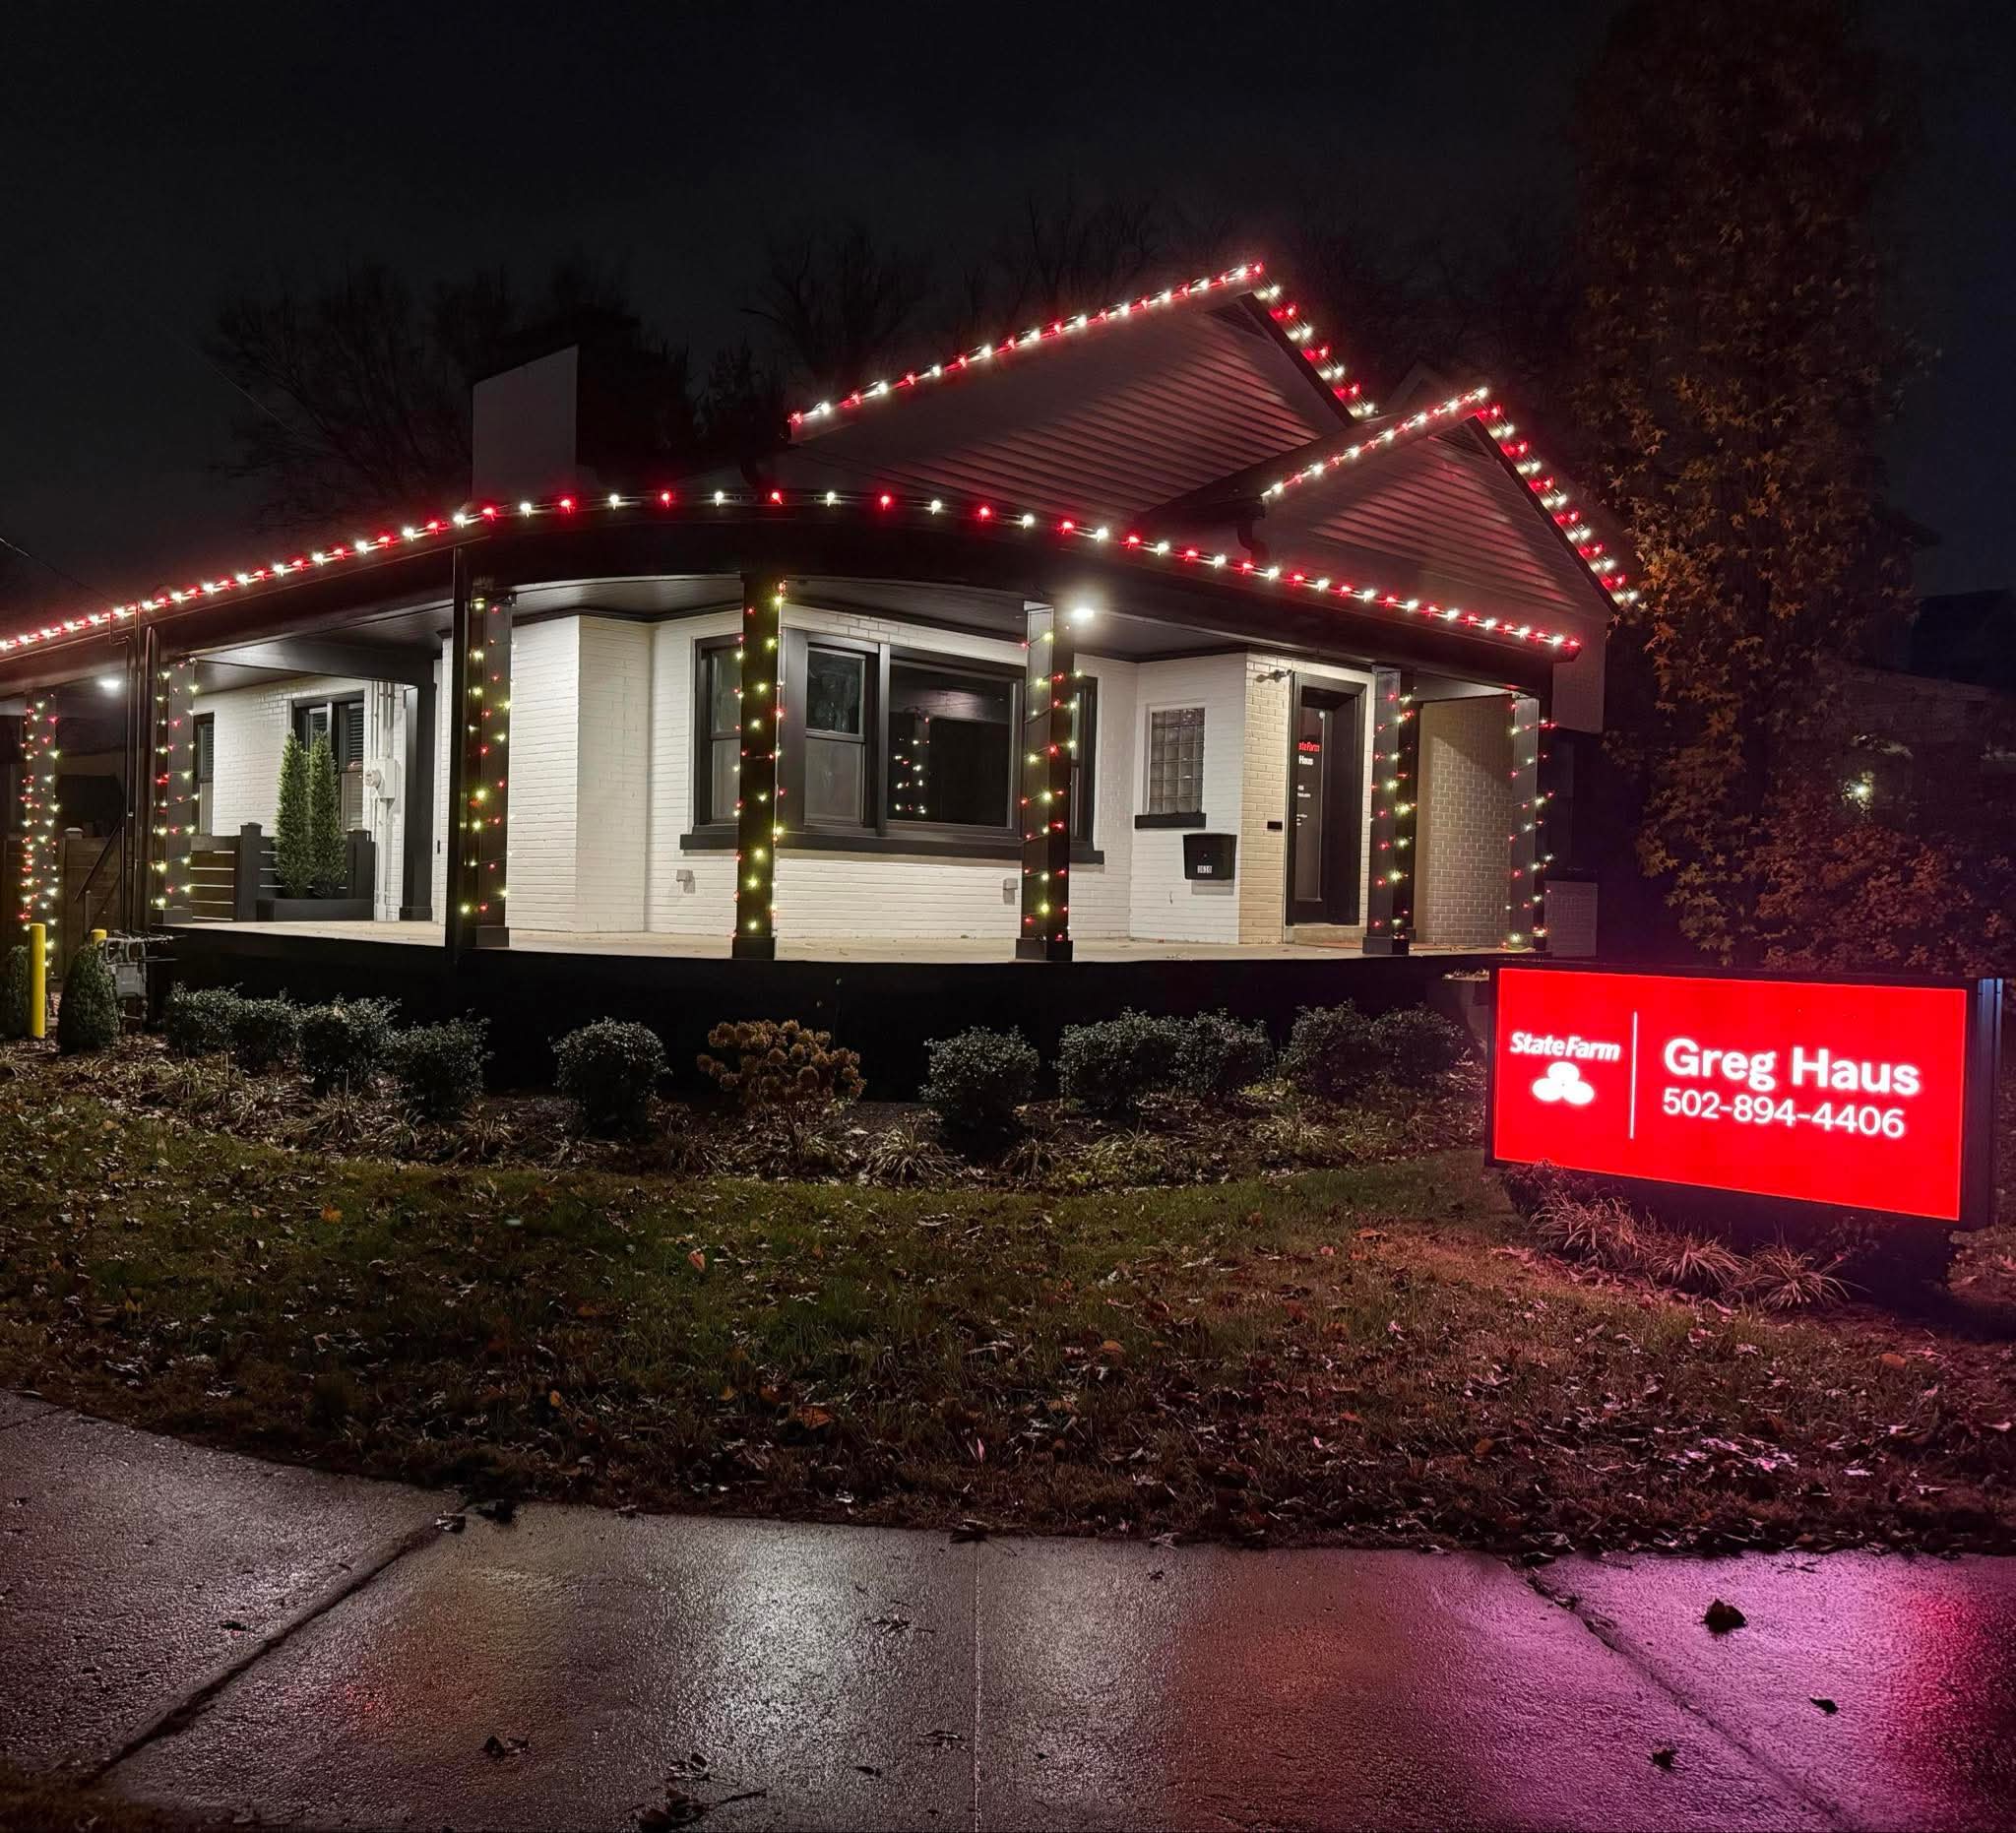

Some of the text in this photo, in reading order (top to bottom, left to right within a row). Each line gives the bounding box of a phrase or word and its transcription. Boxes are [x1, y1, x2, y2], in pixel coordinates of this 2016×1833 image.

[1664, 1038, 1921, 1096] Greg Haus
[1664, 1088, 1905, 1138] 502-894-4406
